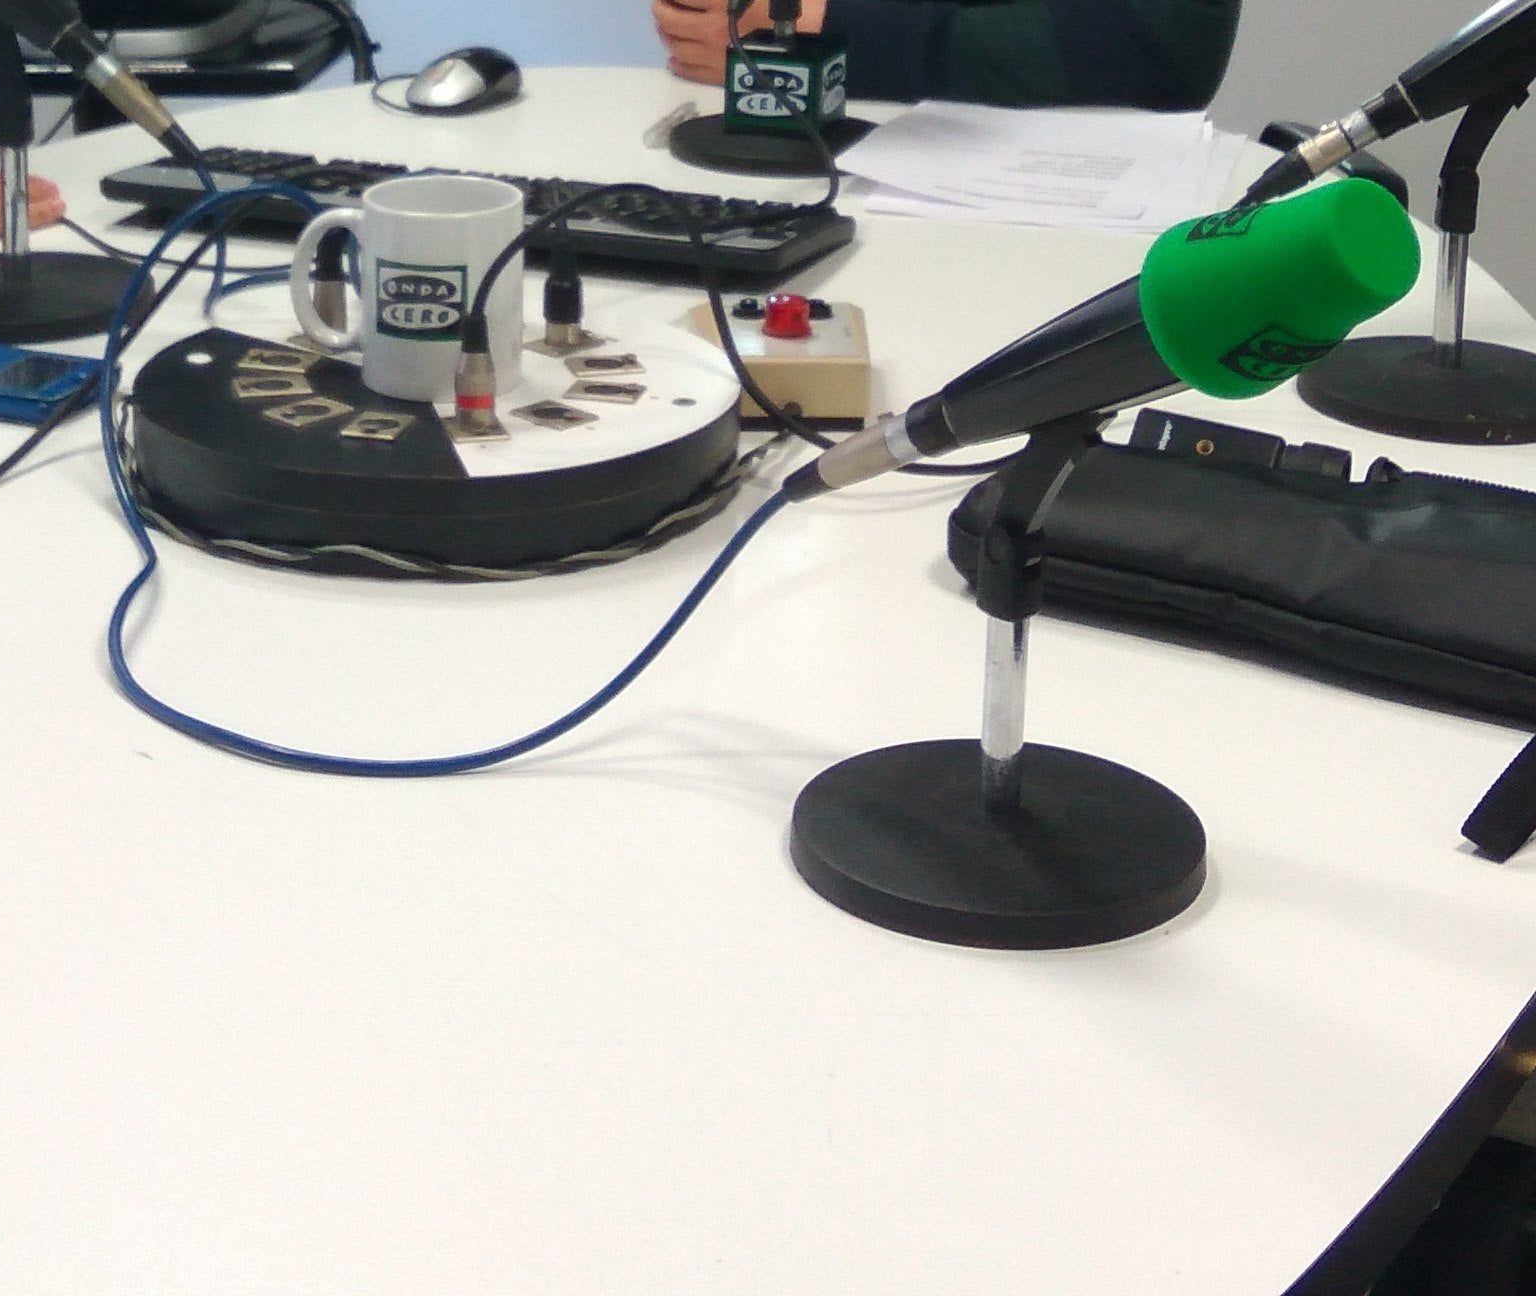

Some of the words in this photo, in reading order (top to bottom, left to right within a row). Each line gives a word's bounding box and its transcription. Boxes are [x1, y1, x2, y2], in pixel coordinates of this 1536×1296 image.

[744, 75, 797, 89] ODA
[388, 281, 449, 297] ONDA
[390, 307, 449, 324] CERO
